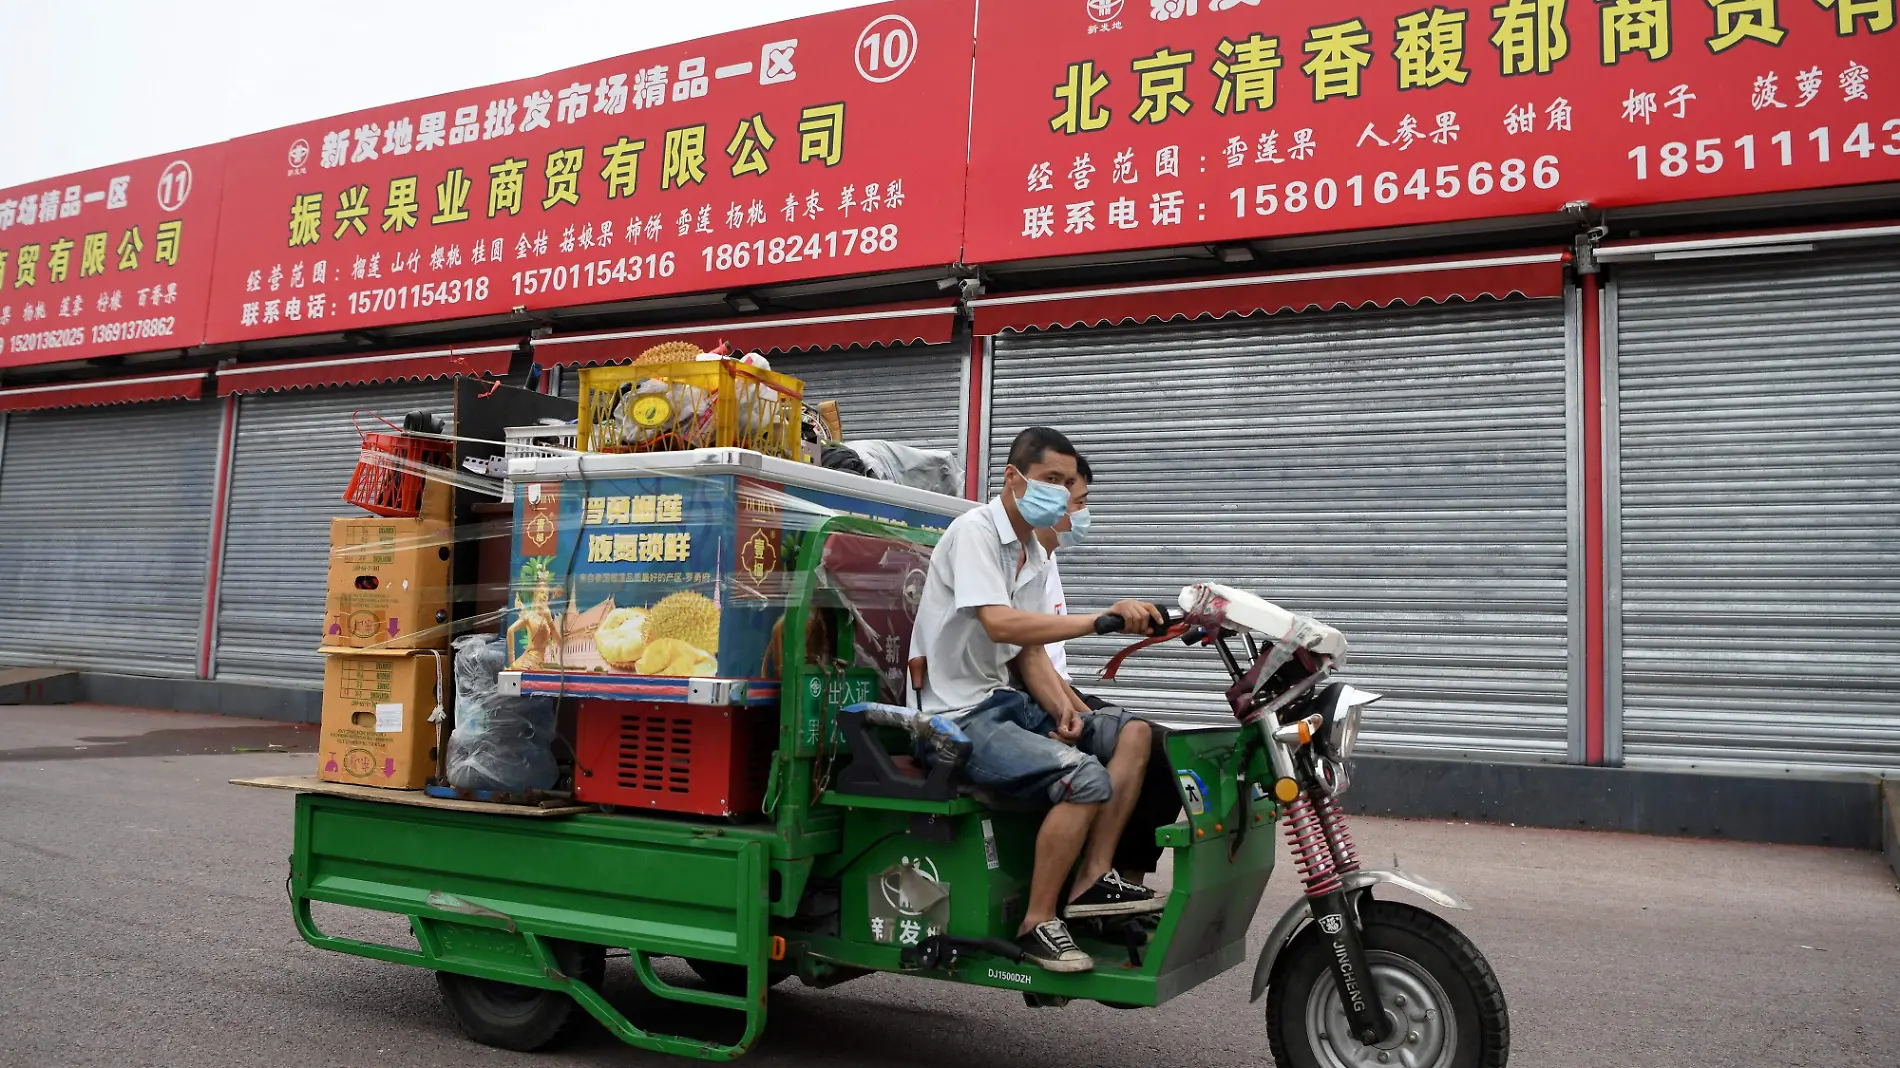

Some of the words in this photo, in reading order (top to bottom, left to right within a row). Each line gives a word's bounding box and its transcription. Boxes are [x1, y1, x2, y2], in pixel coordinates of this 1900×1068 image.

[1087, 20, 1124, 35] 新发地
[320, 38, 798, 169] 新发地果品批发市场精品一区
[1027, 144, 1206, 193] 经营范围：
[1221, 127, 1317, 169] 雪莲果
[1356, 108, 1460, 151] 人参果
[1503, 96, 1573, 136] 甜角
[1621, 84, 1697, 125] 椰子
[1751, 60, 1870, 111] 菠萝蜜
[288, 101, 846, 248] 振兴果业商贸有限公司
[1021, 190, 1205, 239] 联系电话：
[1229, 154, 1560, 218] 15801645686
[352, 252, 382, 281] 榴莲
[391, 249, 421, 273] 山竹
[429, 244, 462, 268] 樱桃
[472, 237, 504, 265] 桂圆
[514, 231, 549, 260] 金桔
[559, 220, 614, 253] 菇娘果
[625, 213, 663, 246] 柿饼
[675, 203, 714, 237] 雪莲
[726, 199, 767, 230] 杨桃
[780, 188, 824, 223] 青枣
[837, 178, 905, 218] 苹果梨
[137, 282, 178, 306] 百香果
[348, 276, 489, 314] 15701154318
[512, 251, 675, 295] 15701154316
[701, 224, 898, 271] 18618241788
[92, 316, 175, 343] 13691378862
[828, 681, 870, 704] 出入证
[988, 968, 1032, 985] DJ1500DZH
[1333, 941, 1366, 1012] JINCHENG
